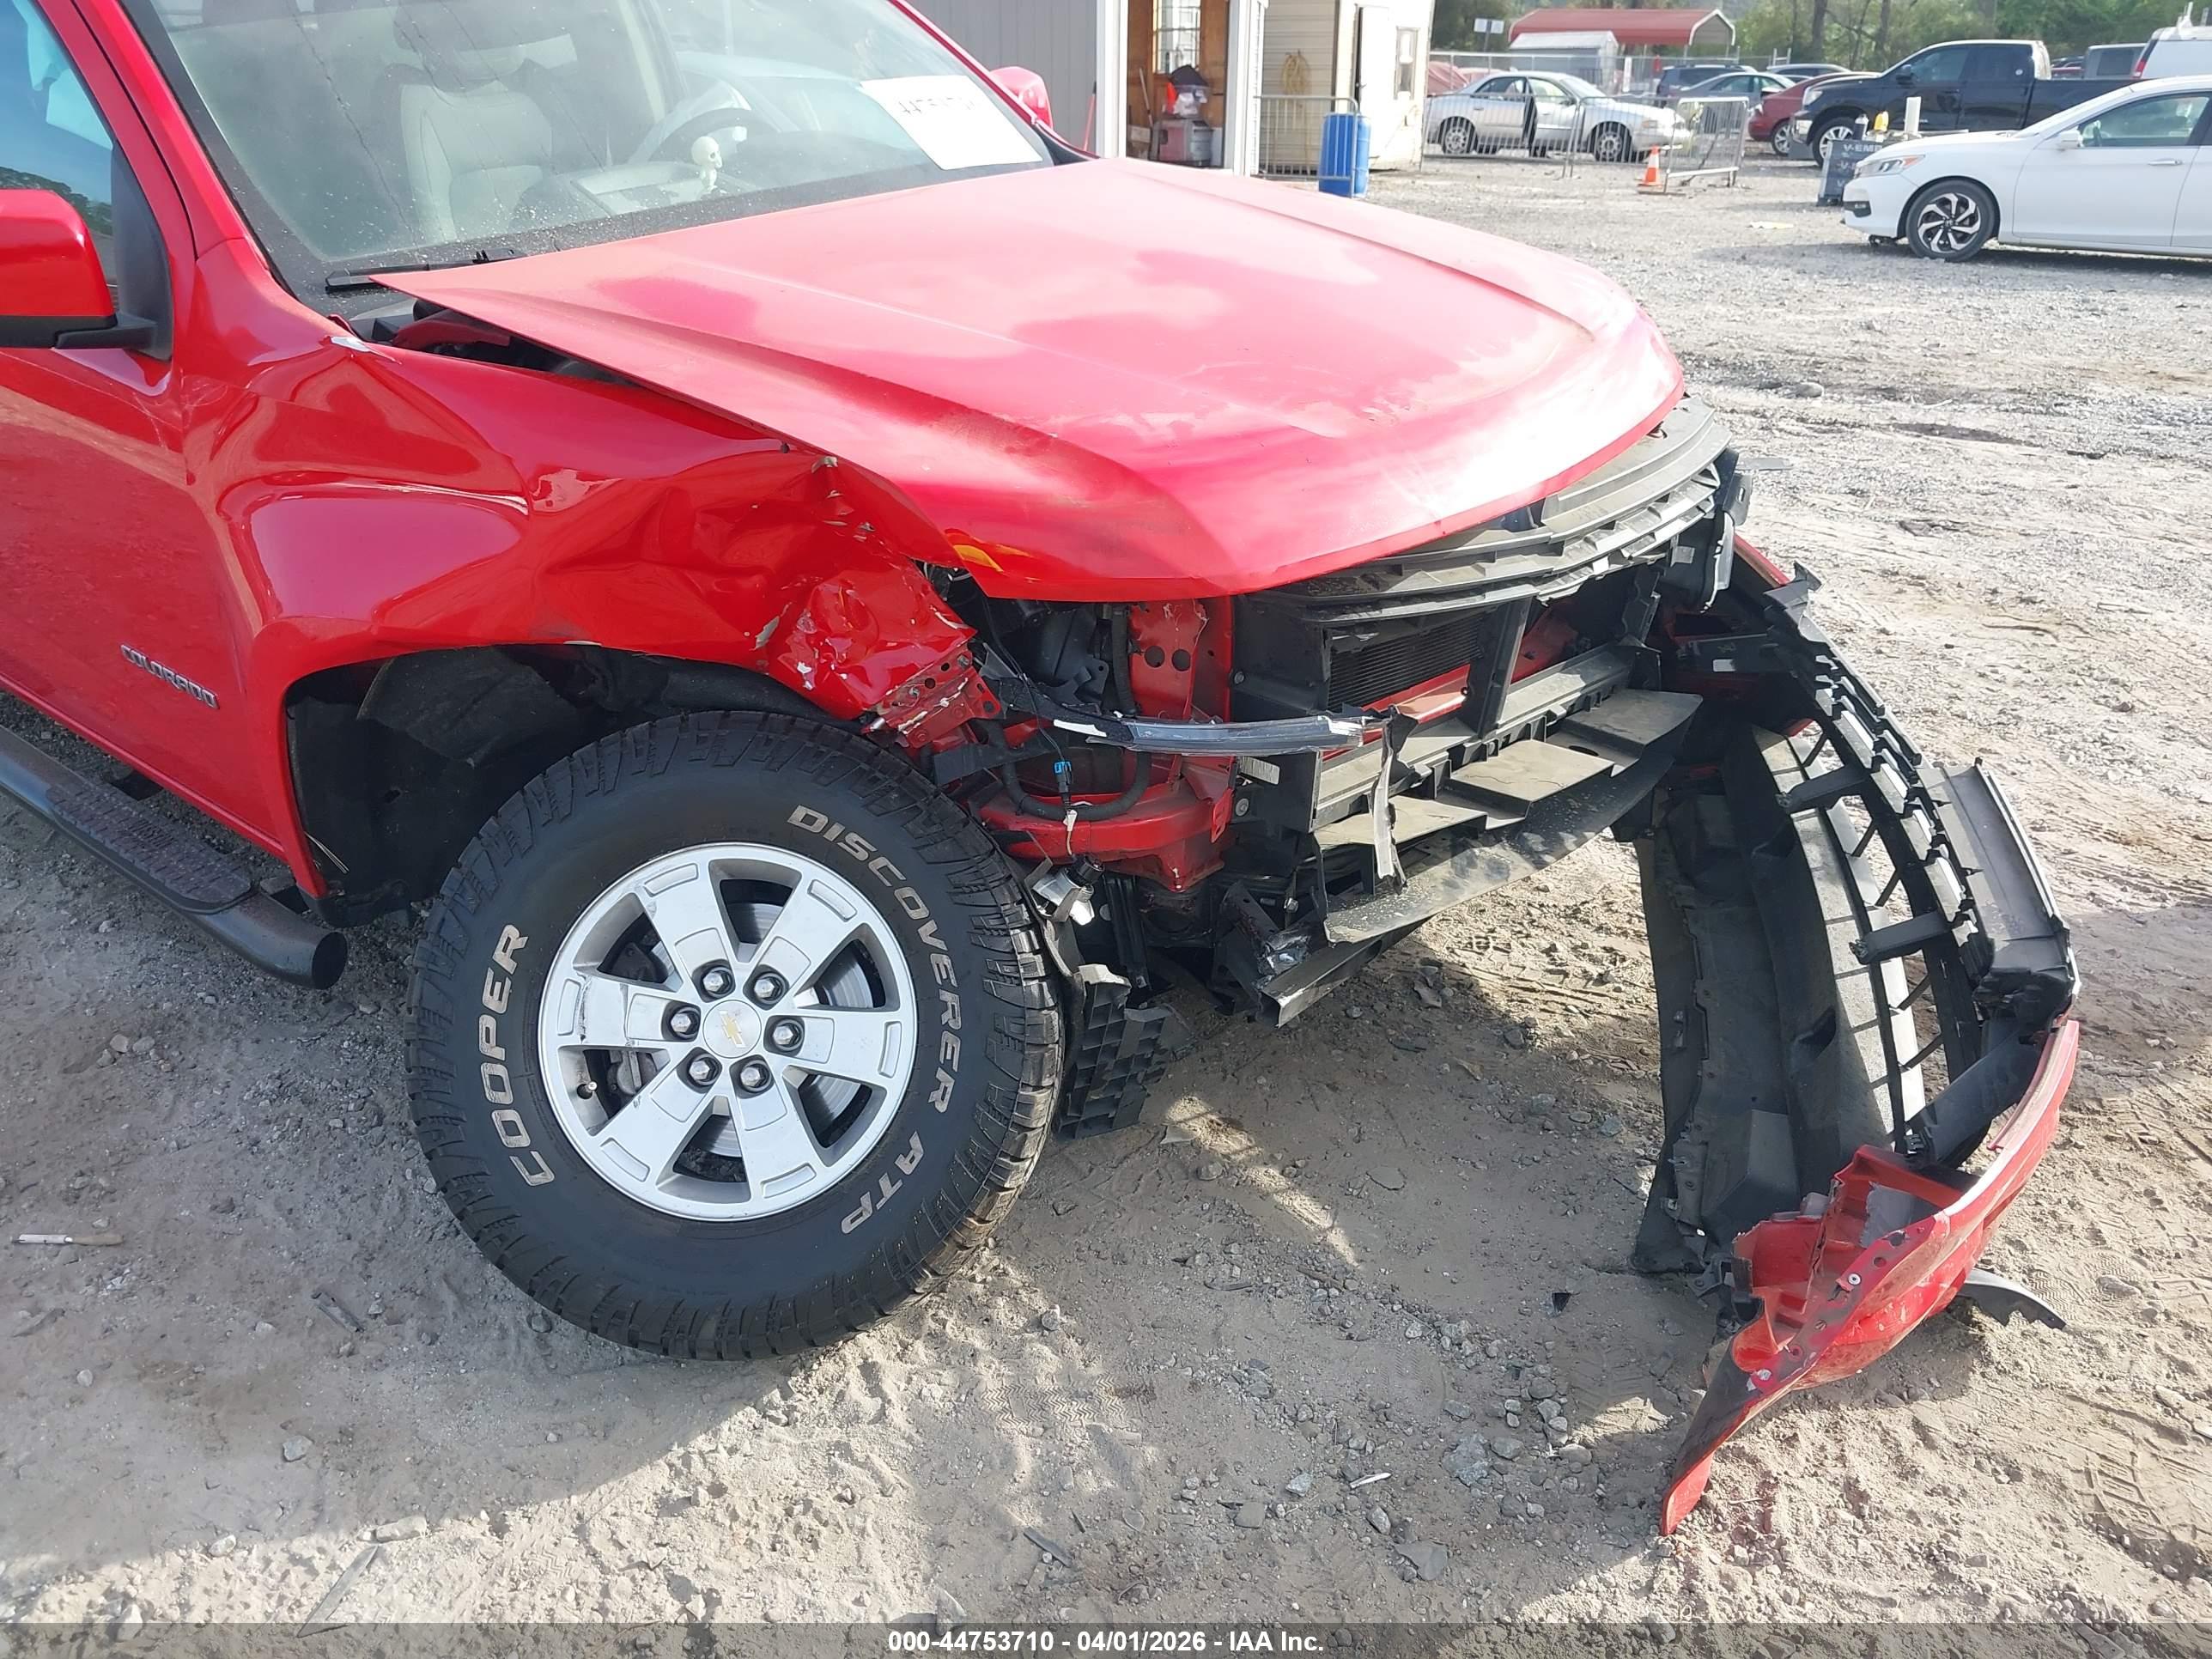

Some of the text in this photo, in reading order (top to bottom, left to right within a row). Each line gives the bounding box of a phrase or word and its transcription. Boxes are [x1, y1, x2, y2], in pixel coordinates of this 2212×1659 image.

[120, 644, 220, 709] COLORADO
[478, 924, 556, 1188] COOPER
[787, 805, 962, 1234] DISCOVERER ATP
